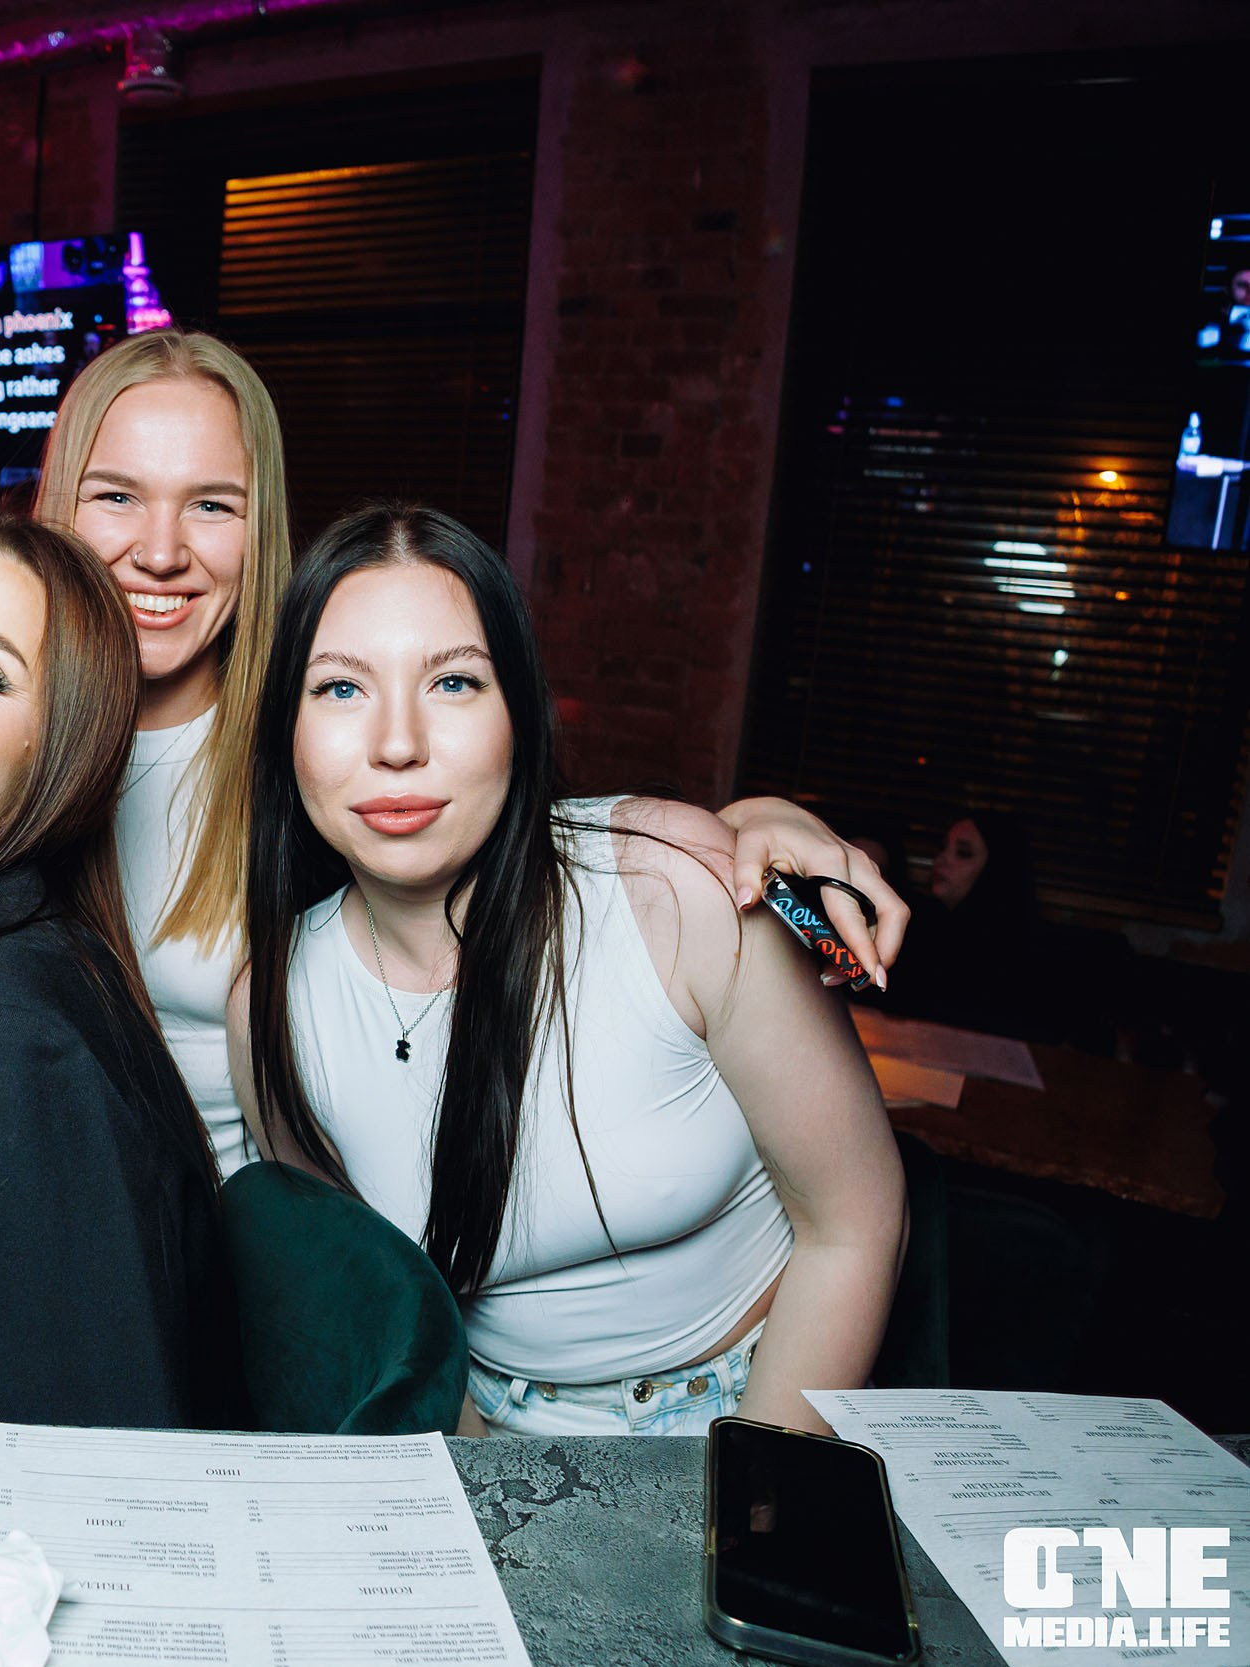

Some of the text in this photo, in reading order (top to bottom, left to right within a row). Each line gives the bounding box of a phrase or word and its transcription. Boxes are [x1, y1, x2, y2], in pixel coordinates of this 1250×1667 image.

[14, 342, 66, 366] ashes
[6, 375, 61, 398] rather
[205, 1467, 241, 1478] ПИВО
[85, 1518, 126, 1527] ДЖИН
[346, 1524, 389, 1533] ВОДКА
[78, 1581, 132, 1592] ТЕКИЛА
[358, 1586, 413, 1596] КОНЬЯК
